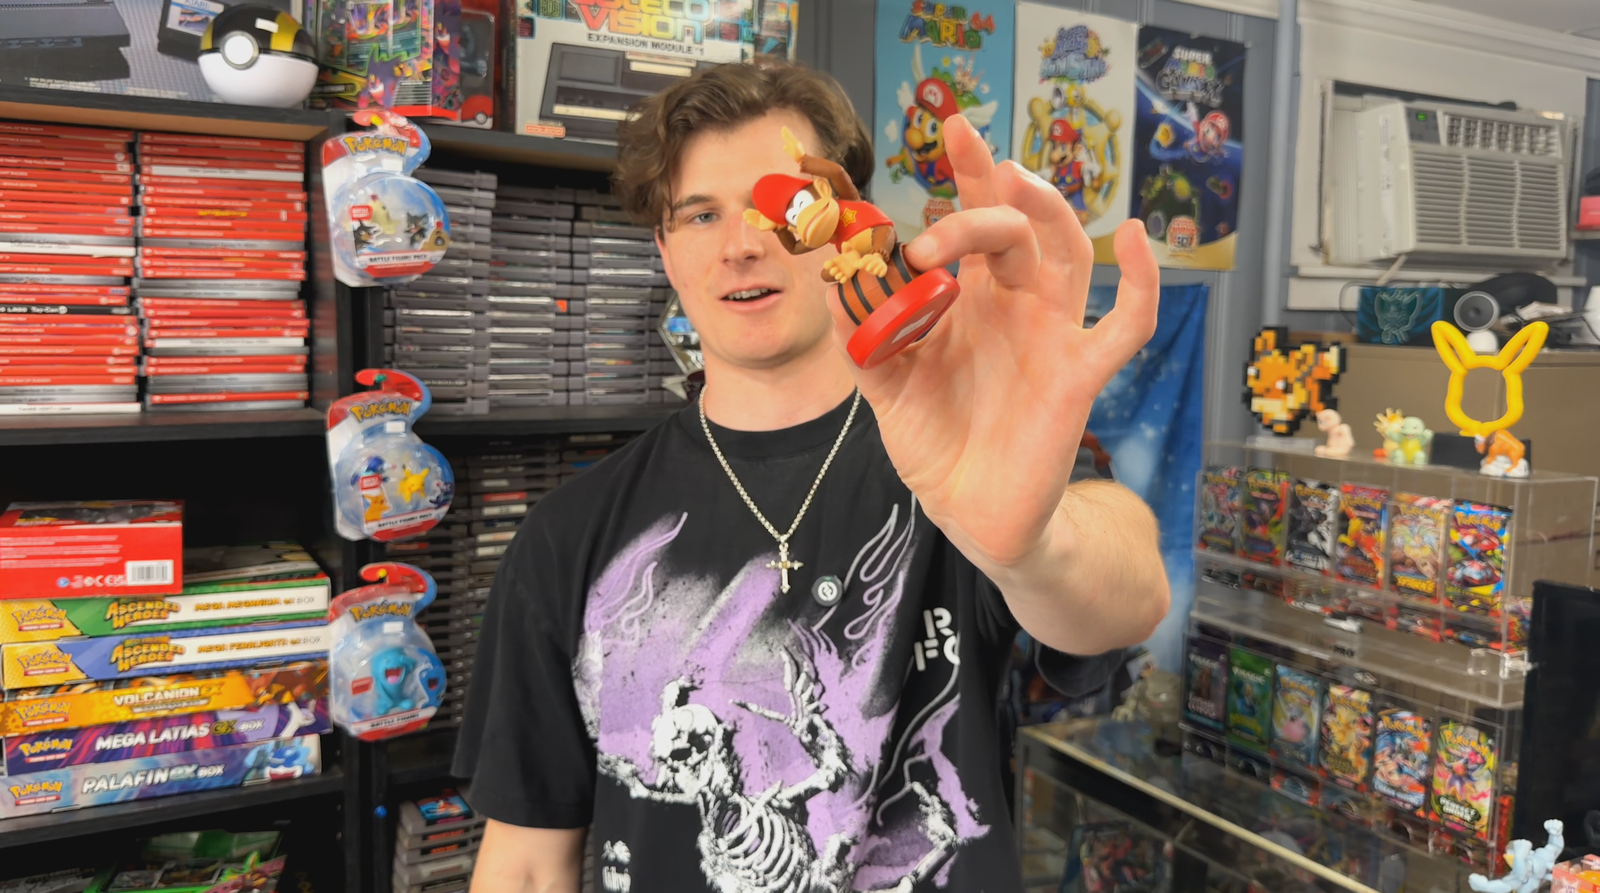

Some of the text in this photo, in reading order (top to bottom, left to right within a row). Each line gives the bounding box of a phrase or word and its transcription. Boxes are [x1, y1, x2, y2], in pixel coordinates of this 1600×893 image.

[579, 4, 704, 45] VISION
[899, 11, 996, 51] MARIO 64
[587, 33, 648, 49] EXPANSION
[650, 41, 692, 55] MODULE
[369, 255, 390, 263] BATTLE
[112, 609, 170, 630] HEROES
[117, 651, 175, 673] HEROES
[113, 686, 200, 706] VOLCANION
[95, 731, 146, 751] MEGA
[148, 722, 211, 745] LATIAS
[238, 719, 264, 733] BOX
[81, 766, 170, 794] PALAFIN
[197, 764, 224, 779] BOX
